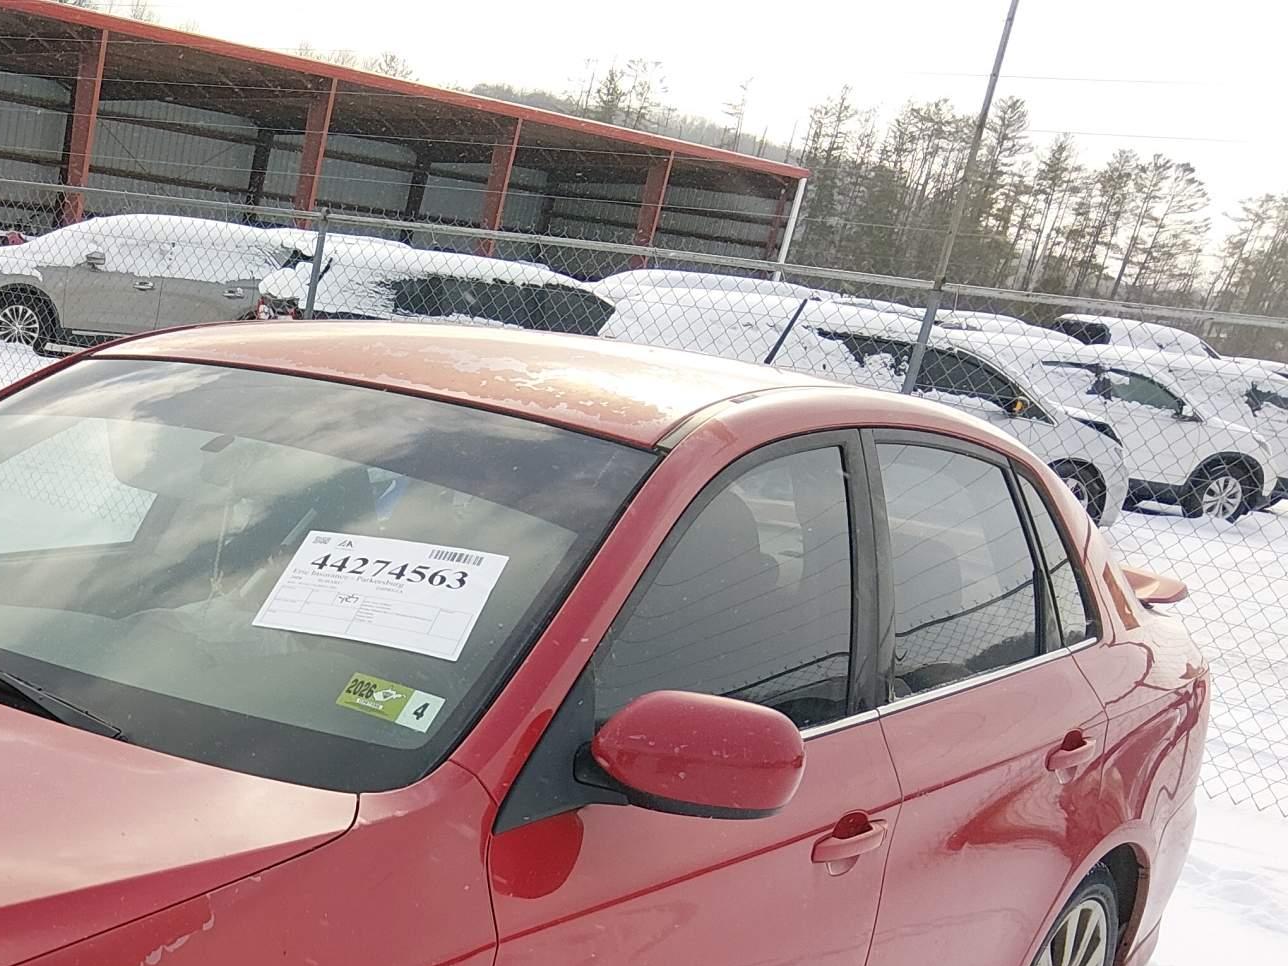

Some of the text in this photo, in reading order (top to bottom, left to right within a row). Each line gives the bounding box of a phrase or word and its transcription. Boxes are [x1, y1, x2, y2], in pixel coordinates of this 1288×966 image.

[310, 553, 469, 590] 44274563
[345, 678, 377, 699] 2026
[412, 702, 430, 720] 4
